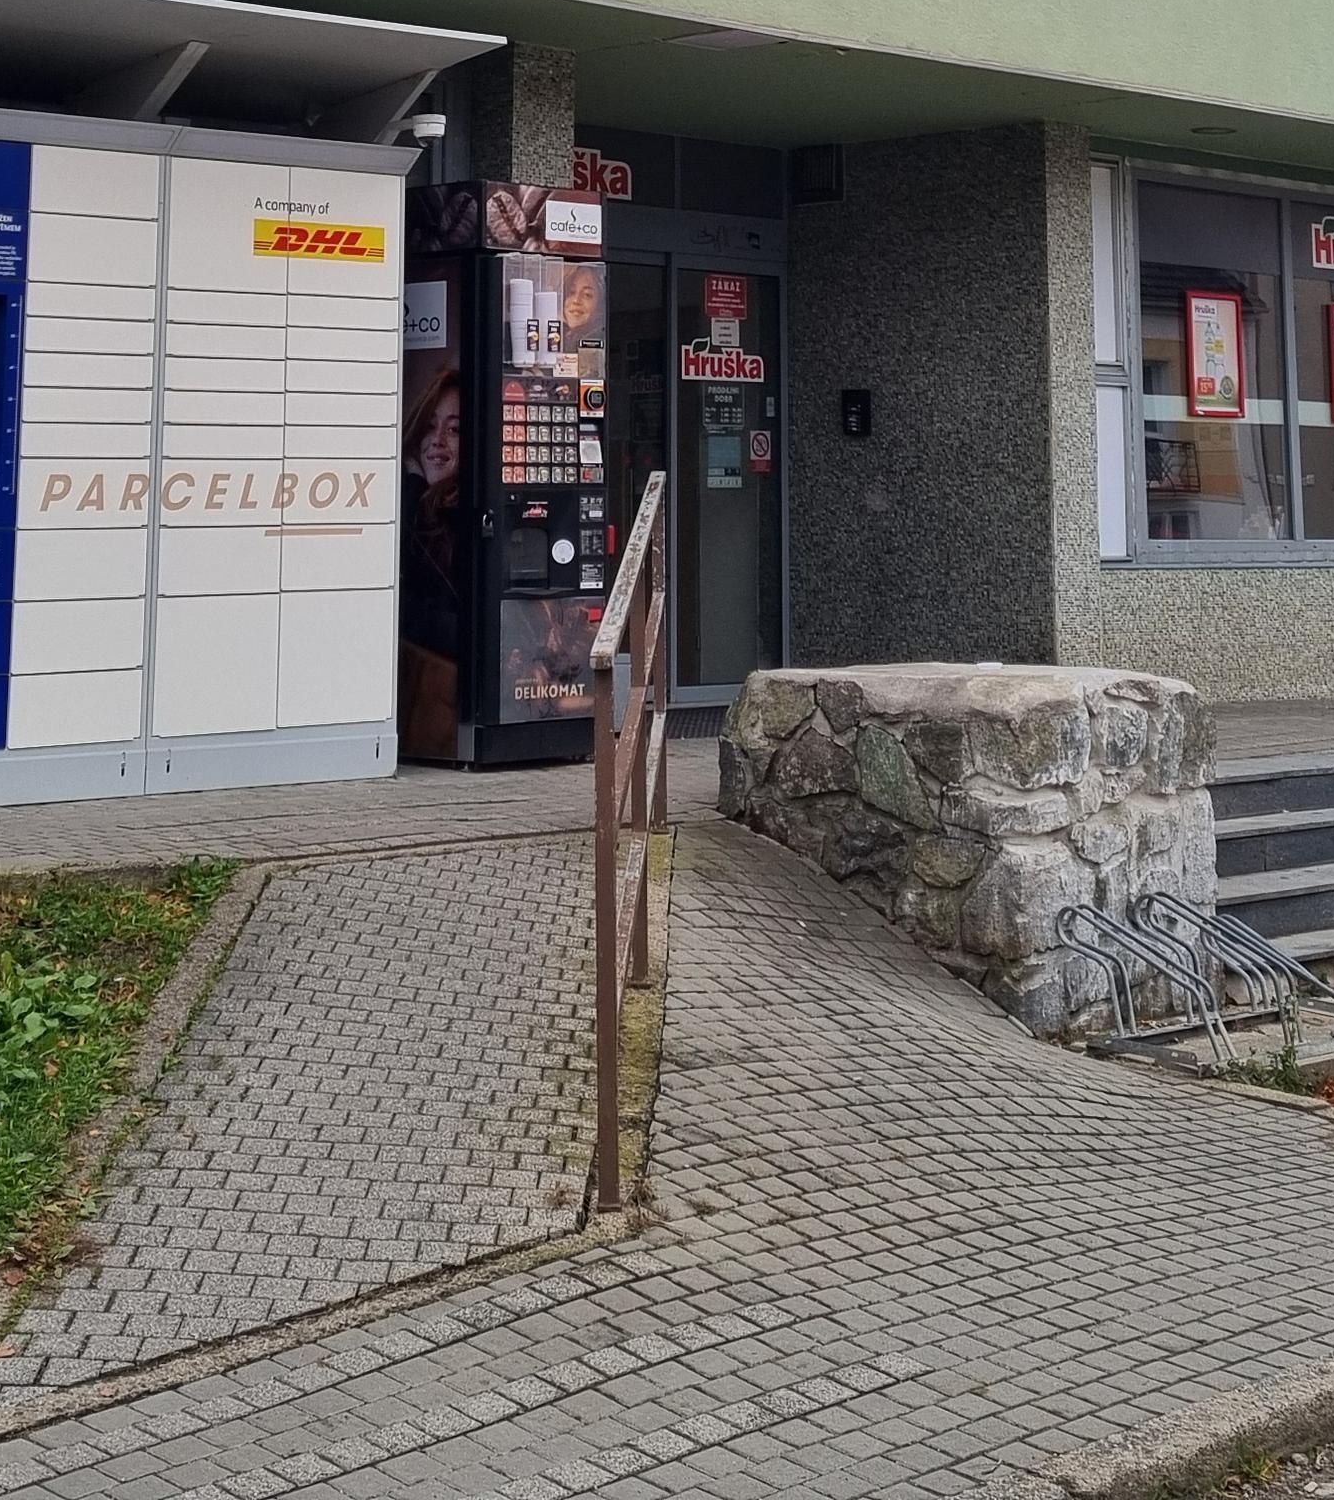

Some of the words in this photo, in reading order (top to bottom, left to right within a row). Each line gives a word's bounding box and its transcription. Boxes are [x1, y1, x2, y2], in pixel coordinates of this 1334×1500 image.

[573, 151, 629, 195] ška
[254, 197, 263, 210] A
[265, 200, 316, 216] company
[318, 203, 330, 214] of
[271, 227, 368, 256] DHL
[684, 348, 761, 378] Hruška
[39, 472, 376, 512] PARCELBOX
[514, 683, 586, 700] DELIKOMAT
